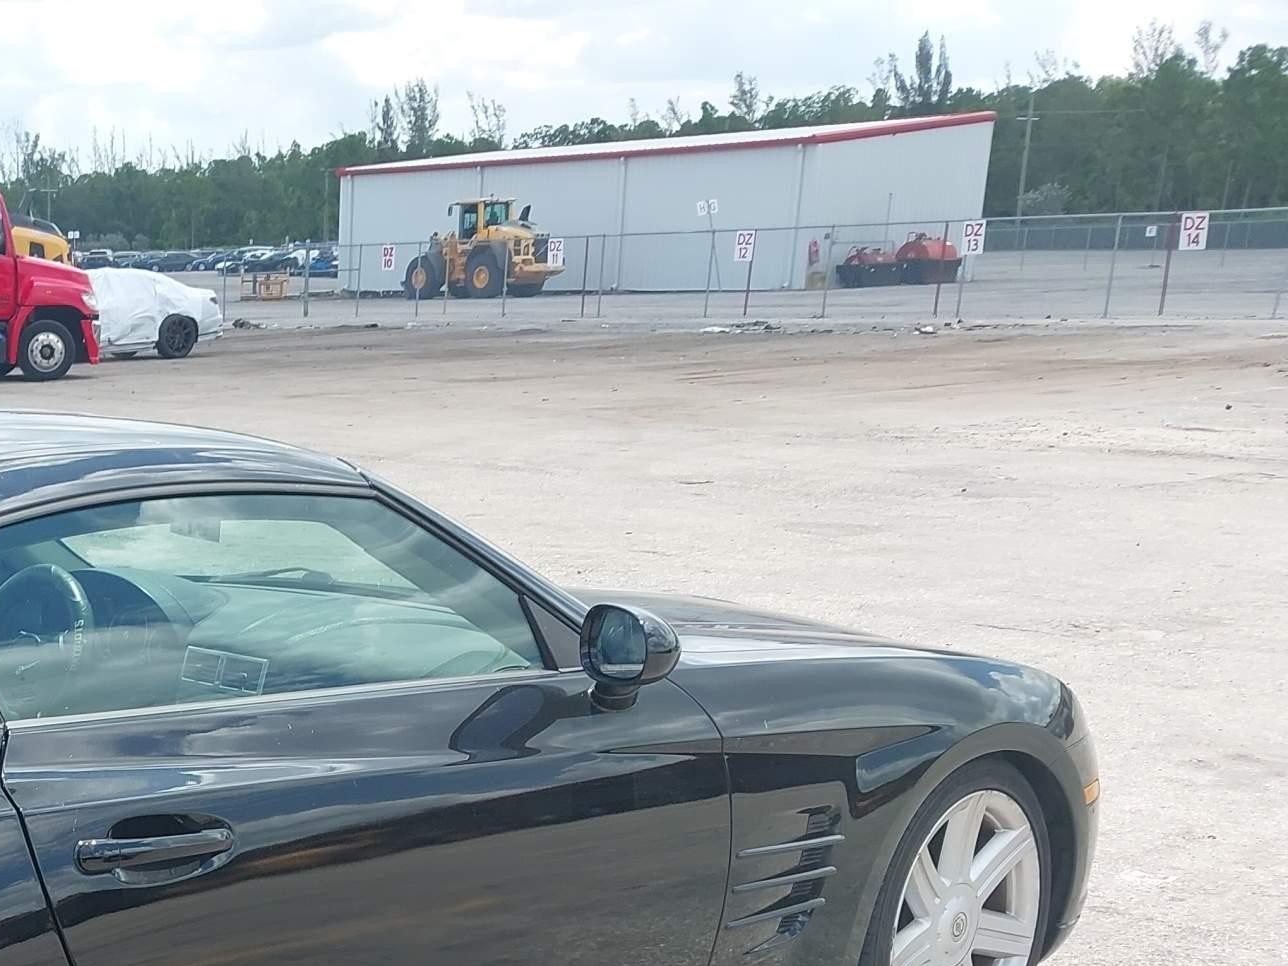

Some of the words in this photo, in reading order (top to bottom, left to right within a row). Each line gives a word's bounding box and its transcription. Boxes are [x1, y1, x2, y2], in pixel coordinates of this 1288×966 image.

[1184, 216, 1207, 231] DZ
[965, 223, 984, 237] DZ
[737, 233, 753, 246] DZ
[967, 238, 979, 252] 13
[1187, 233, 1200, 247] 14
[383, 247, 394, 257] DZ
[550, 240, 562, 252] DZ
[552, 254, 558, 264] 11
[739, 247, 748, 259] 12
[383, 258, 393, 269] 10
